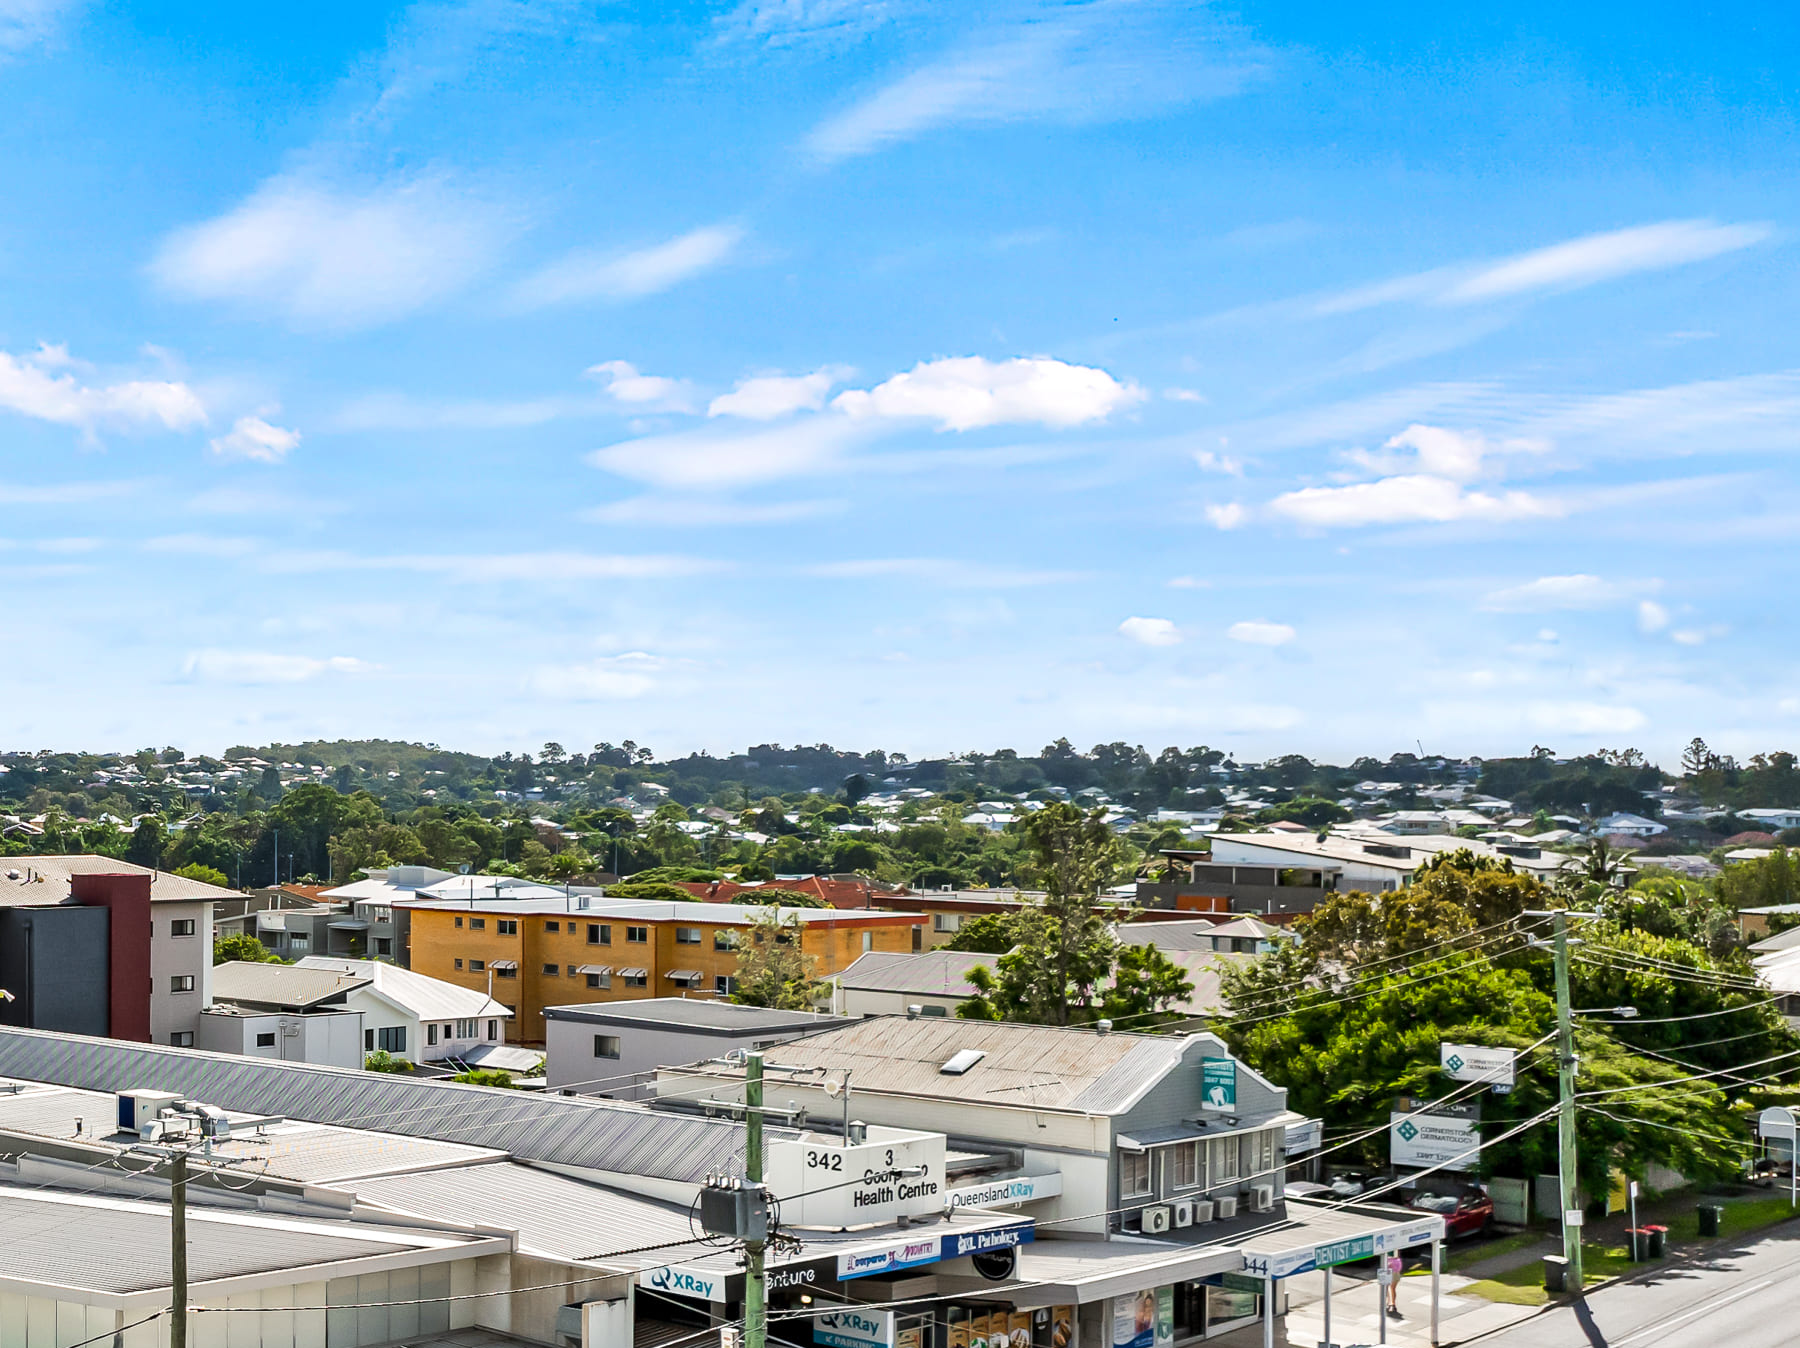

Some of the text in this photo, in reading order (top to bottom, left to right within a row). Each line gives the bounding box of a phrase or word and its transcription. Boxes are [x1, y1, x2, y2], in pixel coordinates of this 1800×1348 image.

[807, 1150, 843, 1172] 342
[885, 1149, 894, 1167] 3
[864, 1164, 929, 1186] Coorpo
[854, 1181, 938, 1208] Health Centre
[1315, 1242, 1351, 1266] DENTIST
[674, 1272, 714, 1298] XRay
[767, 1268, 816, 1291] enture
[842, 1313, 880, 1337] XRay
